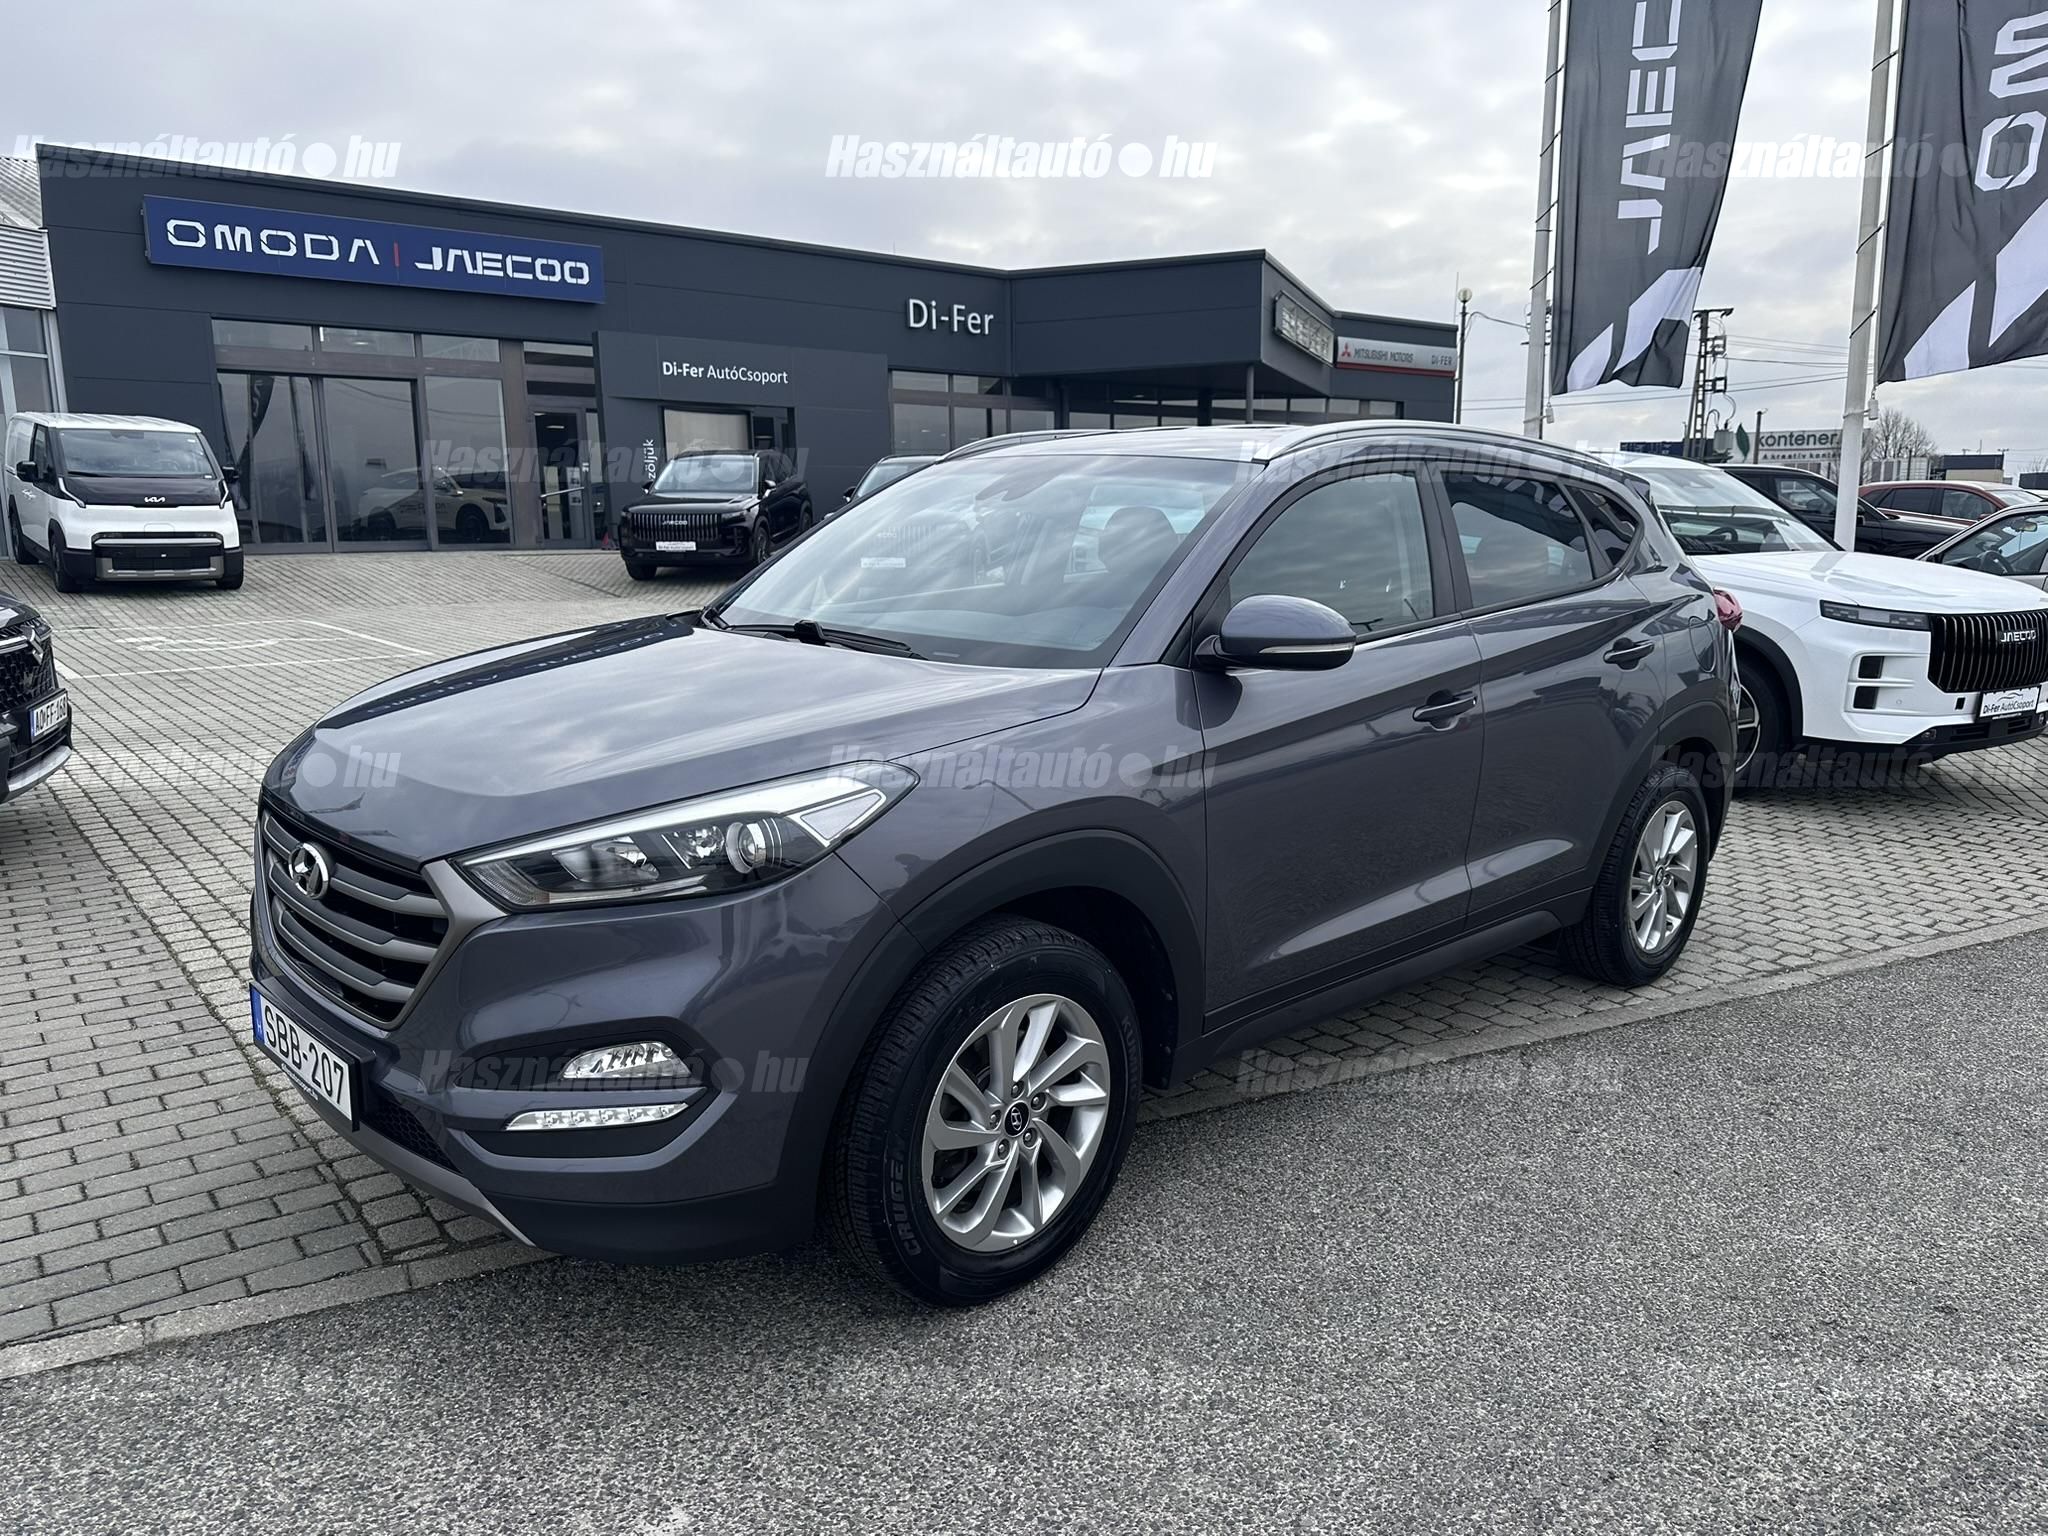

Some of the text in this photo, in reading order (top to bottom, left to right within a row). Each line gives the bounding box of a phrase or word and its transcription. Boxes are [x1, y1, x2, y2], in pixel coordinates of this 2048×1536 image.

[166, 218, 590, 285] OMODA JAECOO
[908, 298, 994, 335] Di-Fer
[1353, 347, 1452, 366] MITSUBISHI MOTORS DI-FER
[662, 361, 789, 385] Di-Fer AutóCsoport
[643, 439, 658, 482] zöljük
[2000, 629, 2037, 643] JAECOO
[1983, 704, 2000, 714] Di-Fer
[264, 1005, 344, 1105] SBB-207
